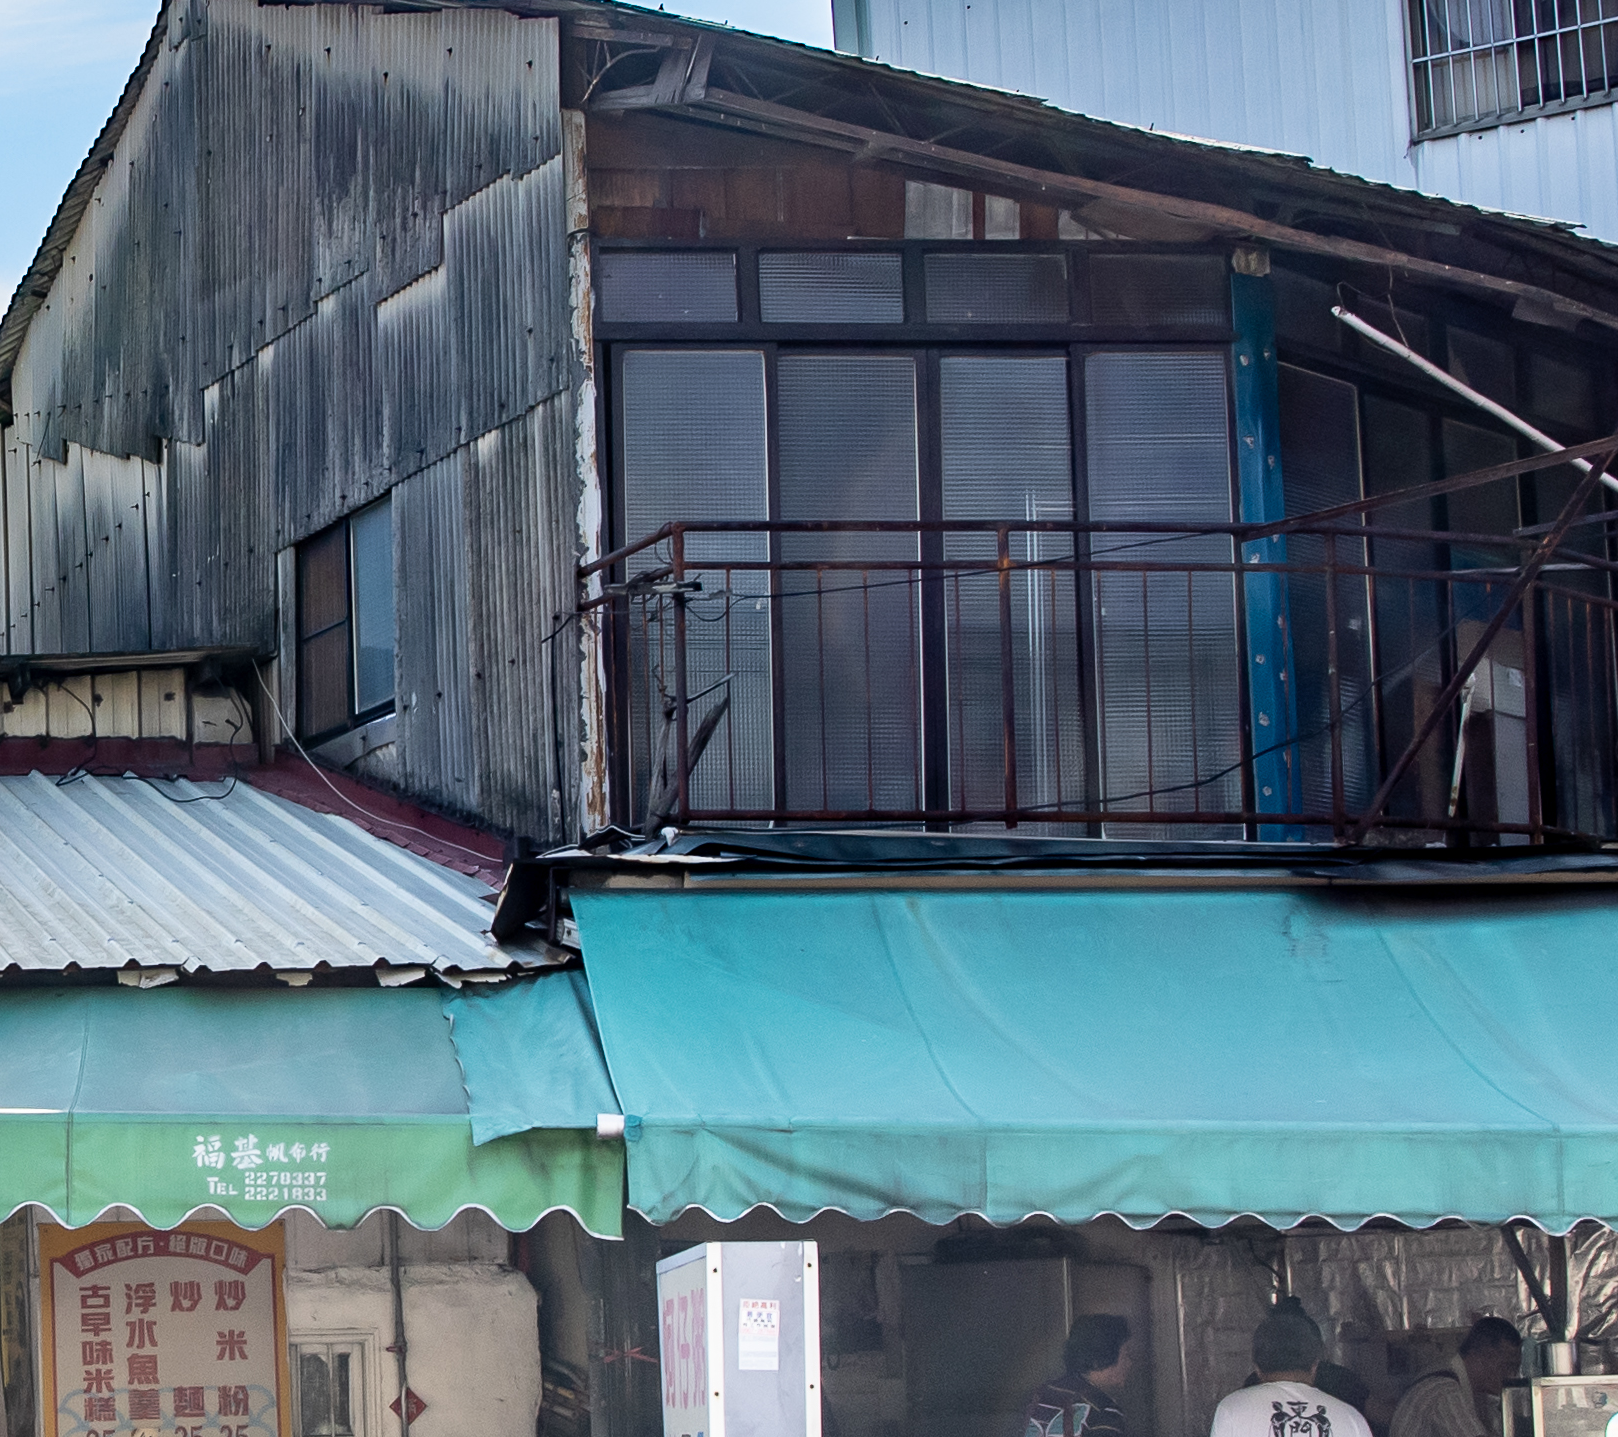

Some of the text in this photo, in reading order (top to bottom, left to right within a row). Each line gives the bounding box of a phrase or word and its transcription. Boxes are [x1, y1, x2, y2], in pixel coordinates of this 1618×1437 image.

[192, 1134, 330, 1170] 福基帆布行
[79, 1284, 116, 1422] 古早味米糕
[124, 1282, 161, 1420] 浮水魚羹
[170, 1280, 206, 1418] 炒麵
[214, 1280, 250, 1417] 炒米粉
